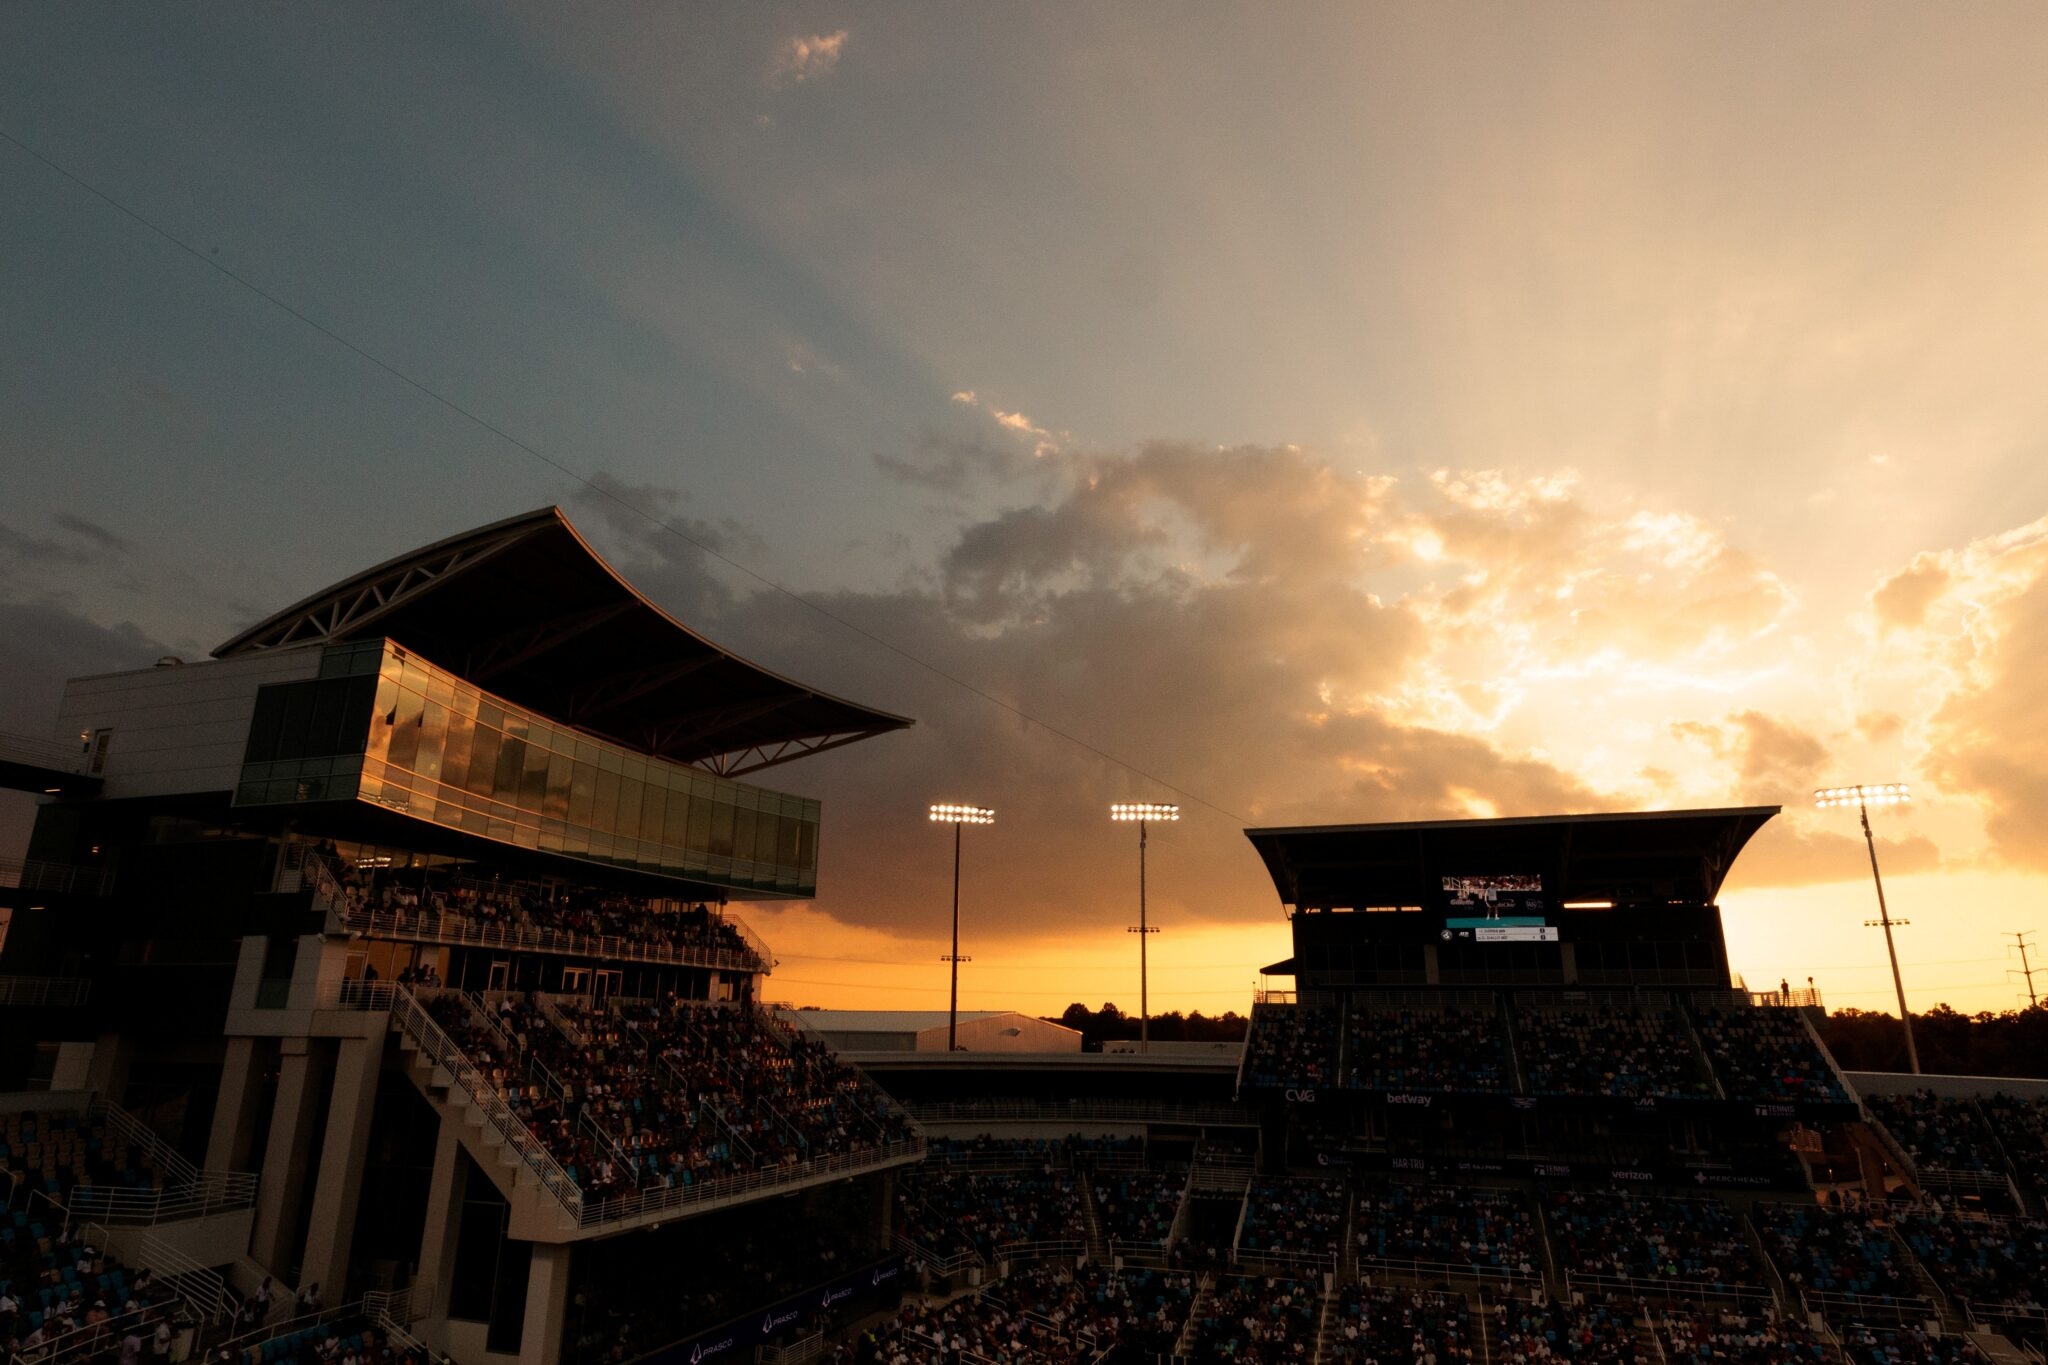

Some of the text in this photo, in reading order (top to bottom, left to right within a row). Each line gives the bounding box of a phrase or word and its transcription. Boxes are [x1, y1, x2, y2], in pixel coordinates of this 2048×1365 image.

[1285, 1089, 1316, 1103] CVG
[1386, 1092, 1432, 1107] betway
[1768, 1104, 1795, 1113] TENNIS
[1392, 1157, 1425, 1169] HAR-TRU
[1611, 1170, 1653, 1181] verizon
[1709, 1175, 1770, 1185] MERCYHEALTH
[830, 1287, 853, 1301] PRASCO
[772, 1311, 798, 1327] PRASCO
[703, 1338, 734, 1357] PRASCO
